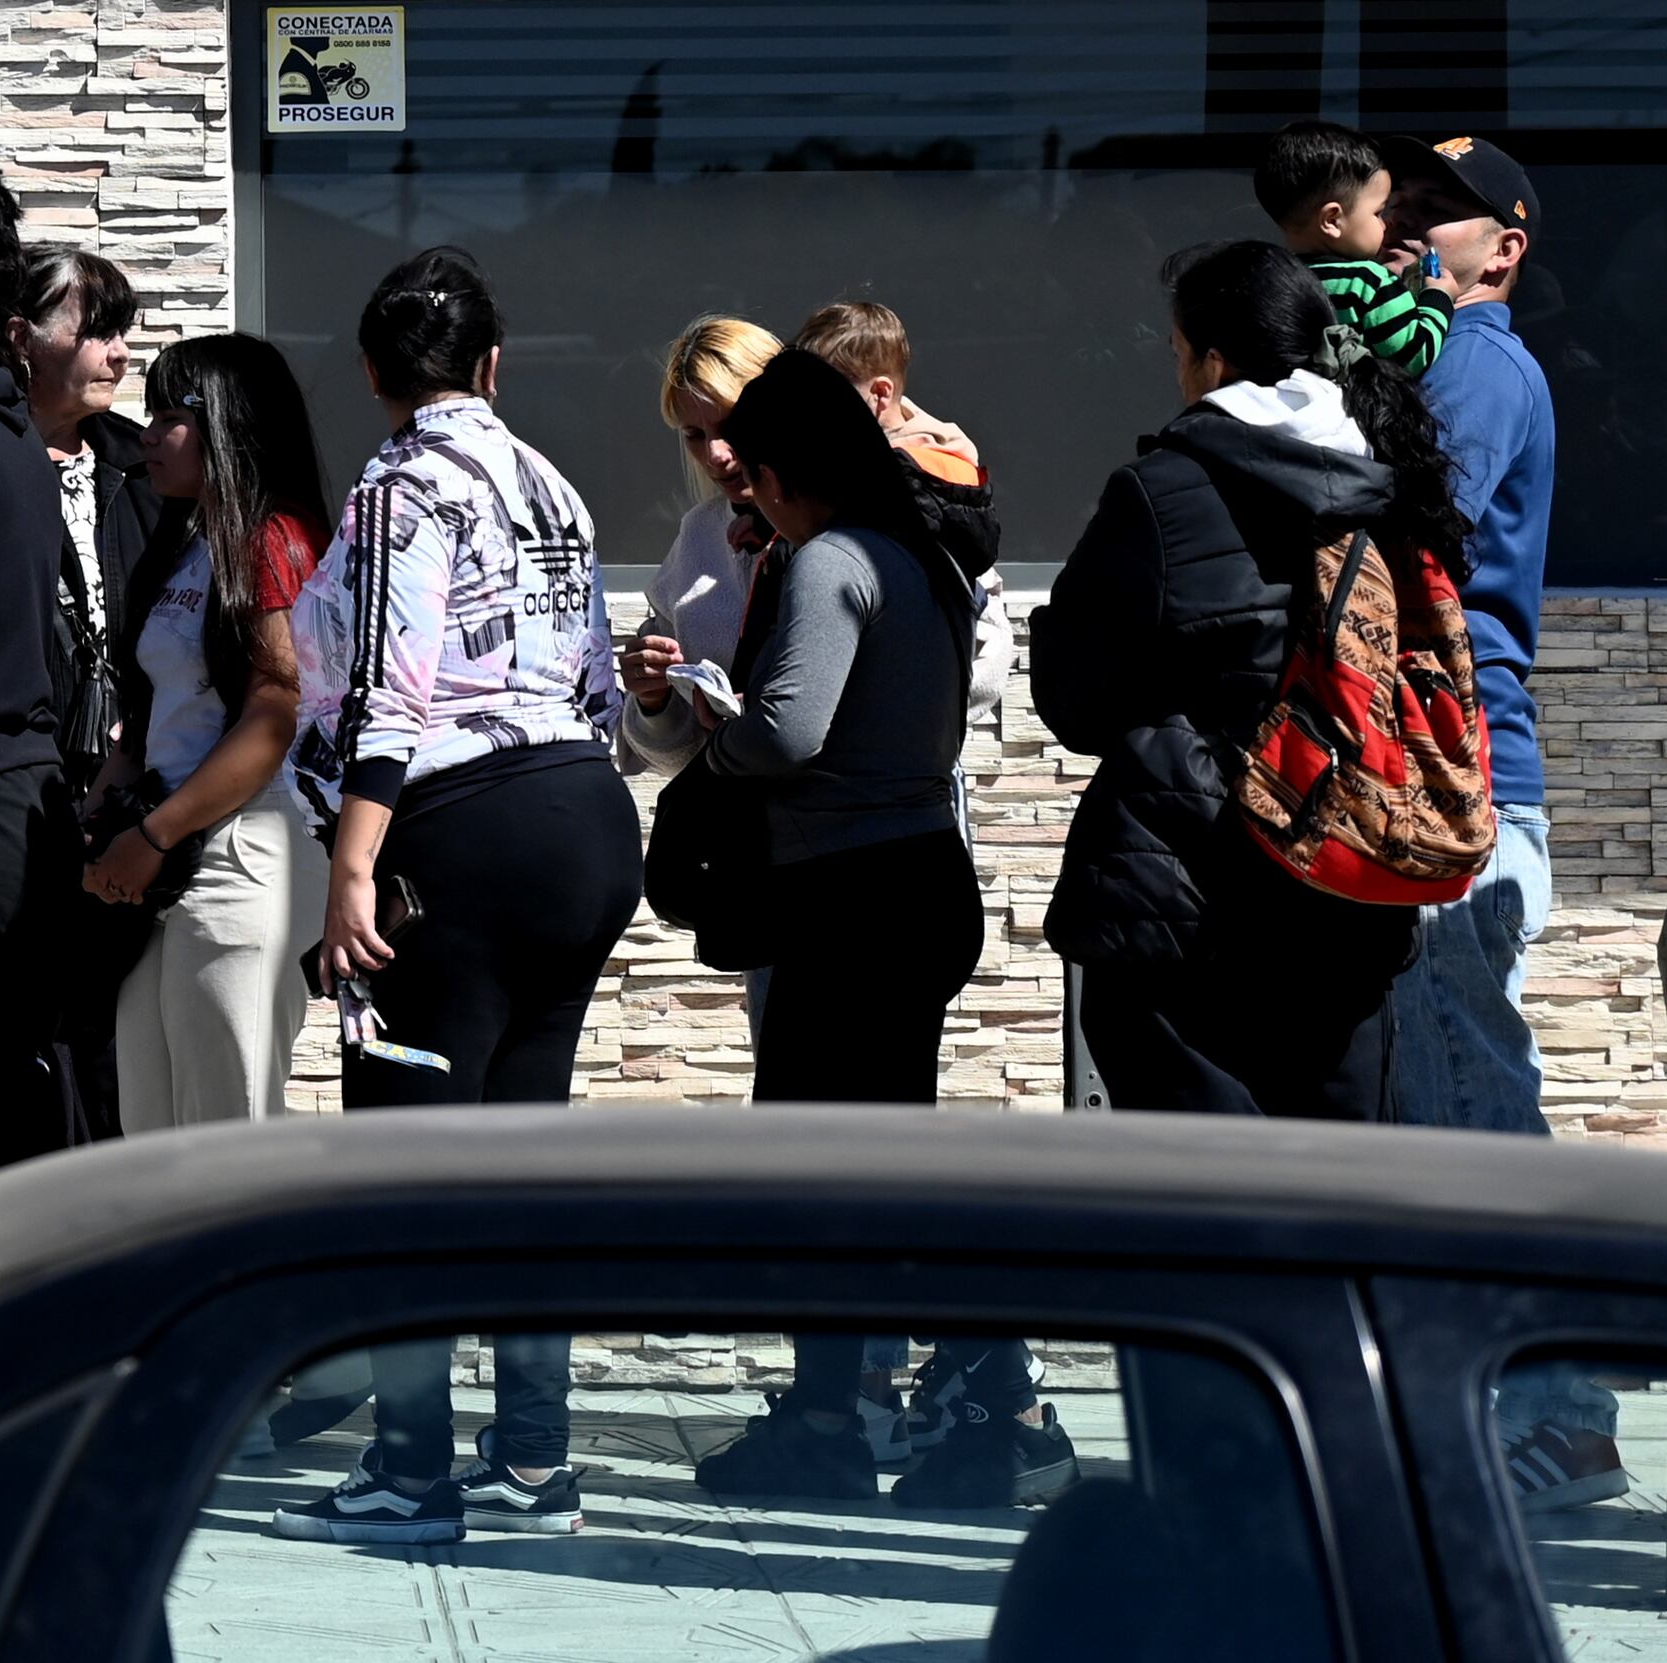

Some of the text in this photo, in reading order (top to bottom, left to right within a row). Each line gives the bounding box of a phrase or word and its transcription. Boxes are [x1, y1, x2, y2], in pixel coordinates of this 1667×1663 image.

[277, 15, 394, 30] CONECTADA
[351, 27, 394, 35] ALARMAS
[278, 106, 395, 122] PROSEGUR
